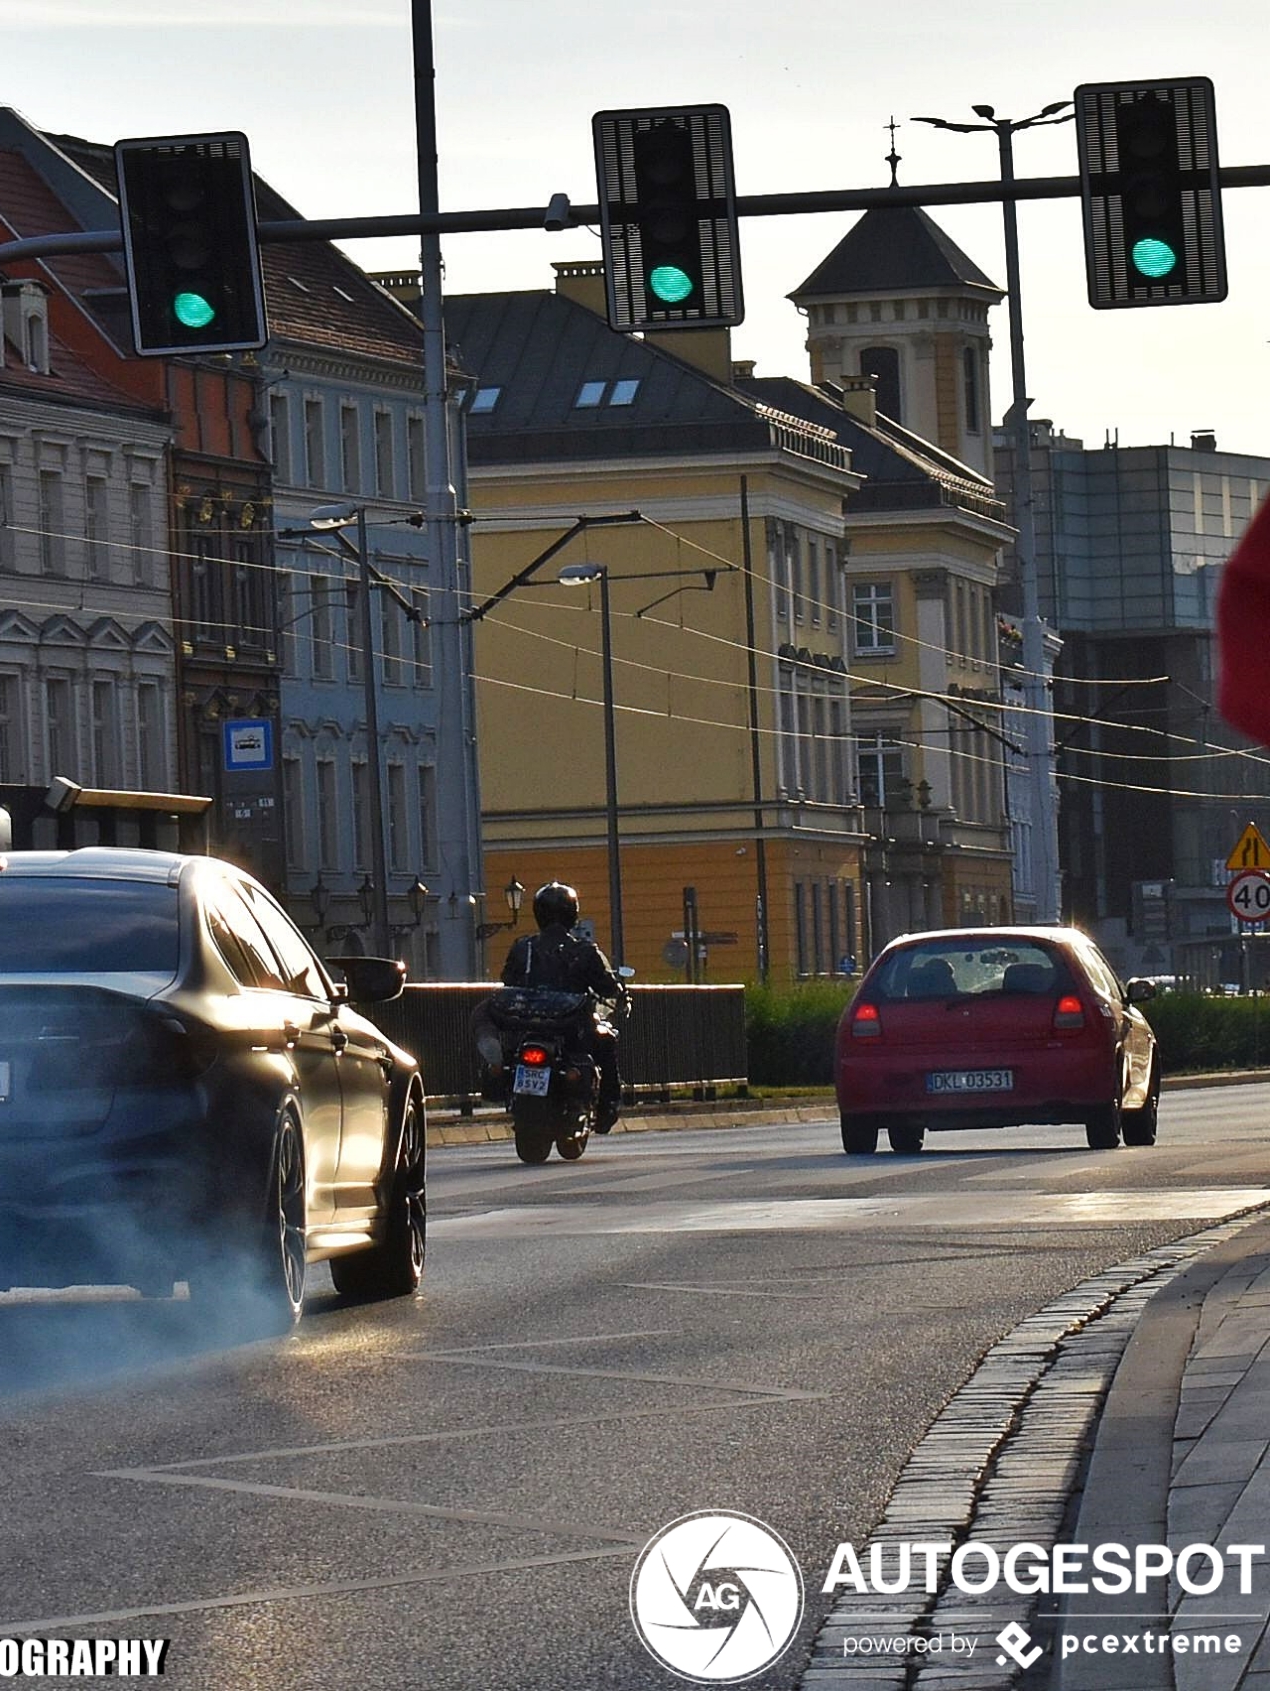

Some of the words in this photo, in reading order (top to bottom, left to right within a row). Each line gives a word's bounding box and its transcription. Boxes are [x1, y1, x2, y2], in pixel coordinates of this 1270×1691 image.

[1234, 884, 1270, 908] 40
[934, 1074, 961, 1089] DKL
[966, 1072, 1010, 1087] 03531
